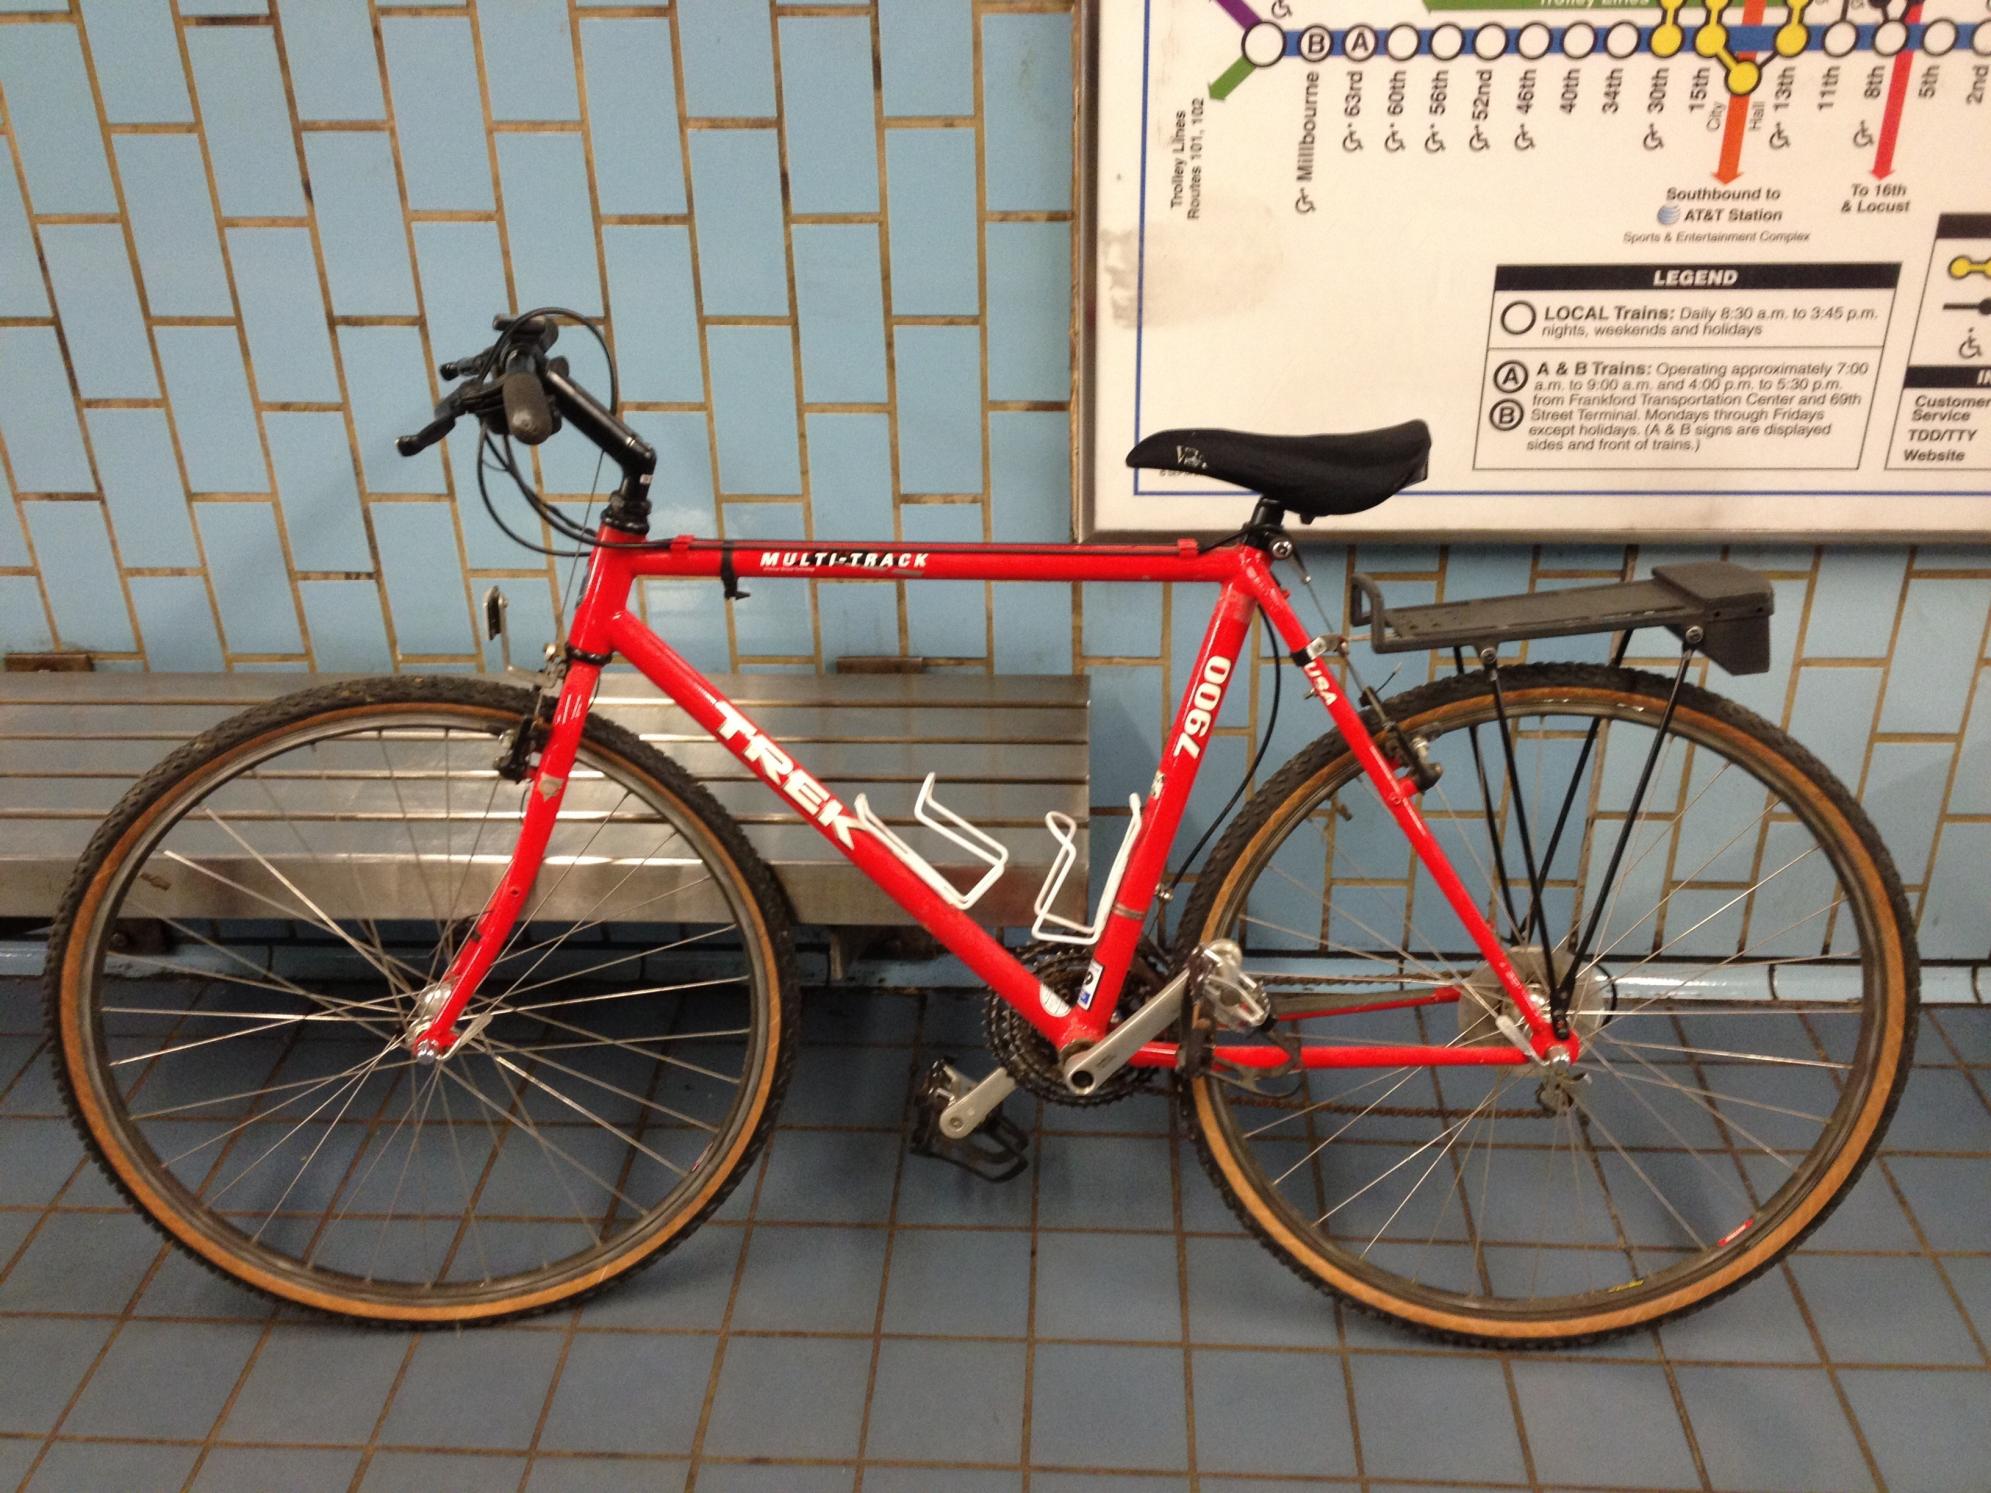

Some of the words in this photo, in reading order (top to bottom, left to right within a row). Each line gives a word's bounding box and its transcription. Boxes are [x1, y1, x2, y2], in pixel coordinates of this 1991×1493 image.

[1307, 32, 1326, 54] B
[1351, 30, 1370, 52] A
[1344, 70, 1364, 117] 63rd
[1387, 70, 1407, 116] 60th
[1429, 69, 1449, 116] 56th
[1472, 69, 1493, 121] 52nd
[1516, 68, 1537, 115] 46th
[1559, 67, 1580, 115] 40th
[1602, 67, 1624, 114] 34th
[1646, 67, 1670, 114] 30th
[1688, 66, 1711, 113] 15th
[1773, 66, 1796, 112] 13th
[1817, 65, 1841, 111] 11th
[1864, 65, 1886, 99] 8th
[1918, 64, 1940, 99] 5th
[1966, 64, 1990, 105] 2nd
[1191, 98, 1204, 125] 102
[1706, 101, 1726, 132] City
[1748, 101, 1765, 131] Hall
[1172, 110, 1186, 153] Lines
[1295, 70, 1320, 182] Millbourne
[1170, 157, 1187, 209] Trolley
[1186, 165, 1202, 220] Routes
[1666, 186, 1761, 201] Southbound
[1766, 187, 1781, 200] to
[1852, 184, 1869, 197] To
[1874, 184, 1907, 197] 16th
[1684, 208, 1725, 222] AT&T
[1728, 208, 1783, 222] Station
[1841, 200, 1852, 213] &
[1857, 200, 1911, 213] Locust
[1623, 231, 1661, 245] Sports
[1676, 231, 1756, 243] Entertainment
[1759, 230, 1811, 244] Complex
[1653, 269, 1739, 287] LEGEND
[1544, 306, 1609, 320] LOCAL
[1614, 306, 1676, 320] Trains:
[1680, 306, 1716, 323] Daily
[1720, 306, 1753, 320] 8:30
[1757, 308, 1788, 320] a.m.
[1792, 306, 1808, 320] to
[1810, 306, 1844, 320] 3:45
[1846, 309, 1878, 322] p.m.
[1594, 324, 1666, 336] weekends
[1670, 324, 1698, 336] and
[1702, 323, 1763, 338] holidays
[1501, 366, 1519, 385] A
[1537, 362, 1549, 375] A
[1556, 362, 1568, 375] &
[1575, 362, 1588, 375] B
[1592, 362, 1652, 375] Trains:
[1656, 362, 1727, 378] Operating
[1731, 362, 1833, 378] approximately
[1836, 362, 1869, 375] 7:00
[1534, 380, 1565, 391] a.m.
[1569, 378, 1583, 391] to
[1588, 378, 1619, 391] 9:00
[1621, 380, 1651, 391] a.m.
[1656, 378, 1684, 391] and
[1688, 378, 1721, 391] 4:00
[1724, 380, 1755, 394] p.m.
[1759, 378, 1773, 391] to
[1776, 378, 1809, 391] 5:30
[1812, 380, 1843, 393] p.m.
[1532, 393, 1565, 406] from
[1568, 393, 1636, 406] Frankford
[1641, 393, 1742, 408] Transportation
[1745, 393, 1796, 406] Center
[1799, 393, 1827, 406] and
[1831, 393, 1862, 406] 69th
[1914, 394, 1991, 408] Customer
[1499, 406, 1515, 424] B
[1530, 408, 1574, 421] Street
[1645, 408, 1710, 423] Mondays
[1714, 408, 1768, 423] through
[1773, 407, 1825, 422] Fridays
[1911, 408, 1972, 421] Service
[1528, 425, 1576, 438] except
[1645, 423, 1661, 438] (A
[1665, 424, 1676, 436] &
[1679, 424, 1691, 436] B
[1695, 424, 1732, 439] signs
[1736, 426, 1760, 436] are
[1763, 423, 1832, 438] displayed
[1908, 428, 1978, 442] TDD/TTY
[1526, 439, 1564, 451] sides
[1567, 439, 1595, 451] and
[1599, 439, 1631, 451] front
[1634, 439, 1648, 451] of
[1903, 448, 1966, 462] Website
[760, 552, 929, 568] MULTI-TRACK
[1304, 661, 1337, 706] USA
[1173, 655, 1231, 759] 7900
[715, 700, 863, 850] TREK
